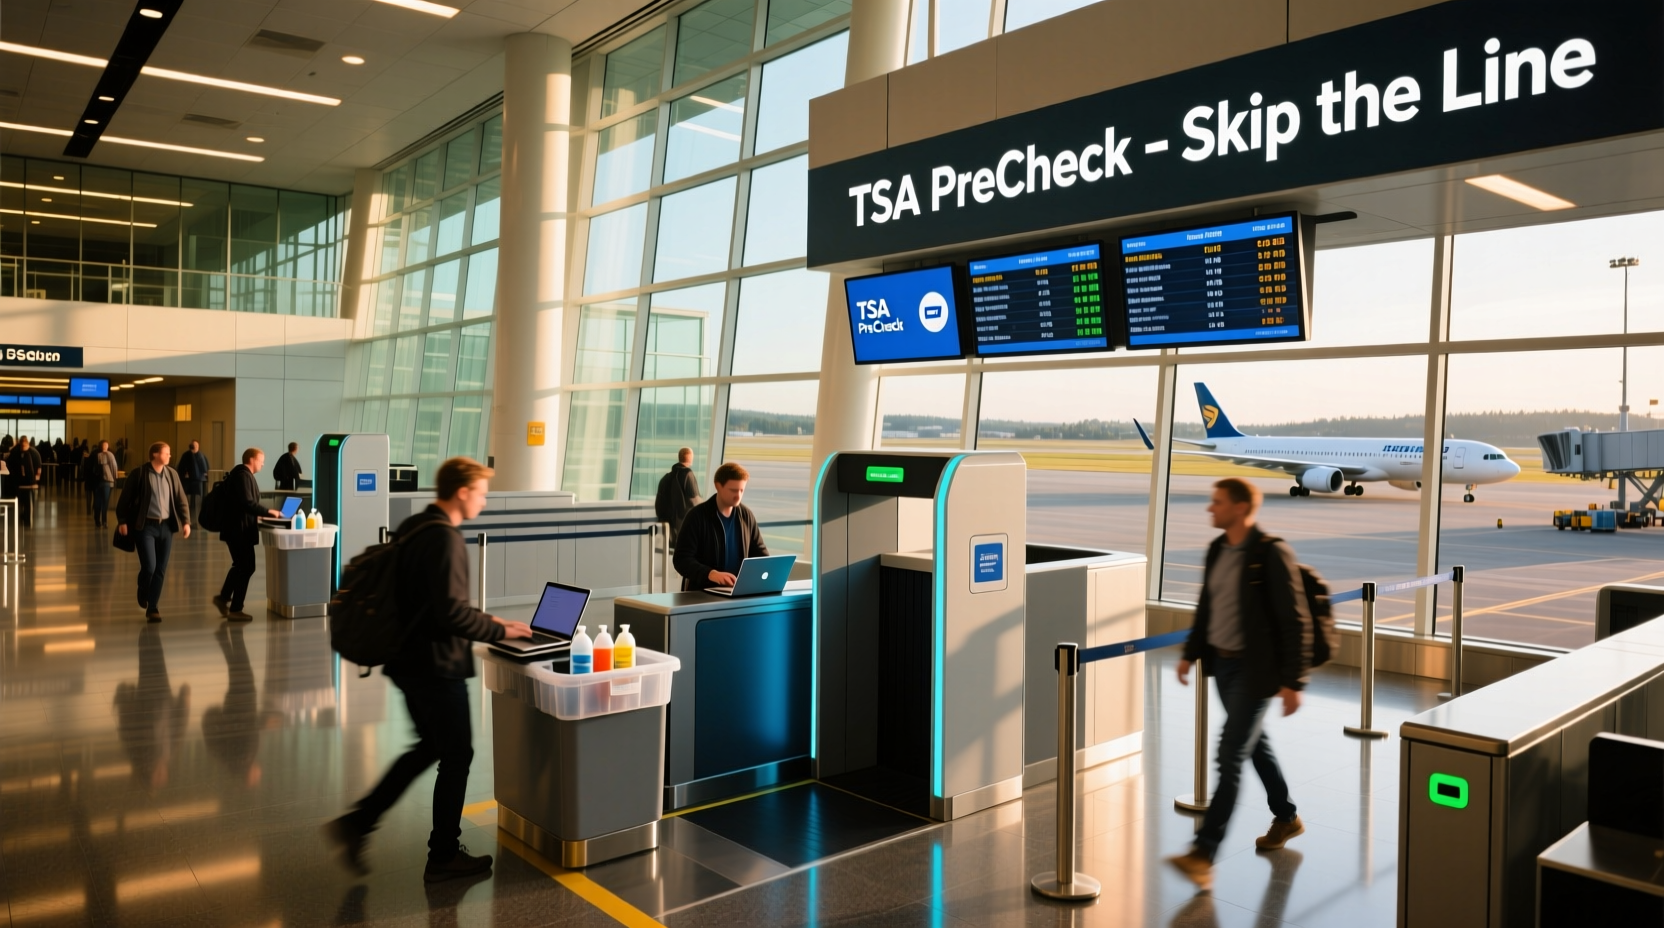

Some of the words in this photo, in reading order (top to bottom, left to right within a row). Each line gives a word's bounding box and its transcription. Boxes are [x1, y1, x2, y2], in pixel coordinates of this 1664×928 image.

[849, 175, 920, 226] TSA
[931, 127, 1132, 212] PreCheck
[1182, 92, 1300, 162] Skip
[1316, 71, 1421, 136] the
[1443, 37, 1596, 113] Line
[856, 298, 891, 320] TSA
